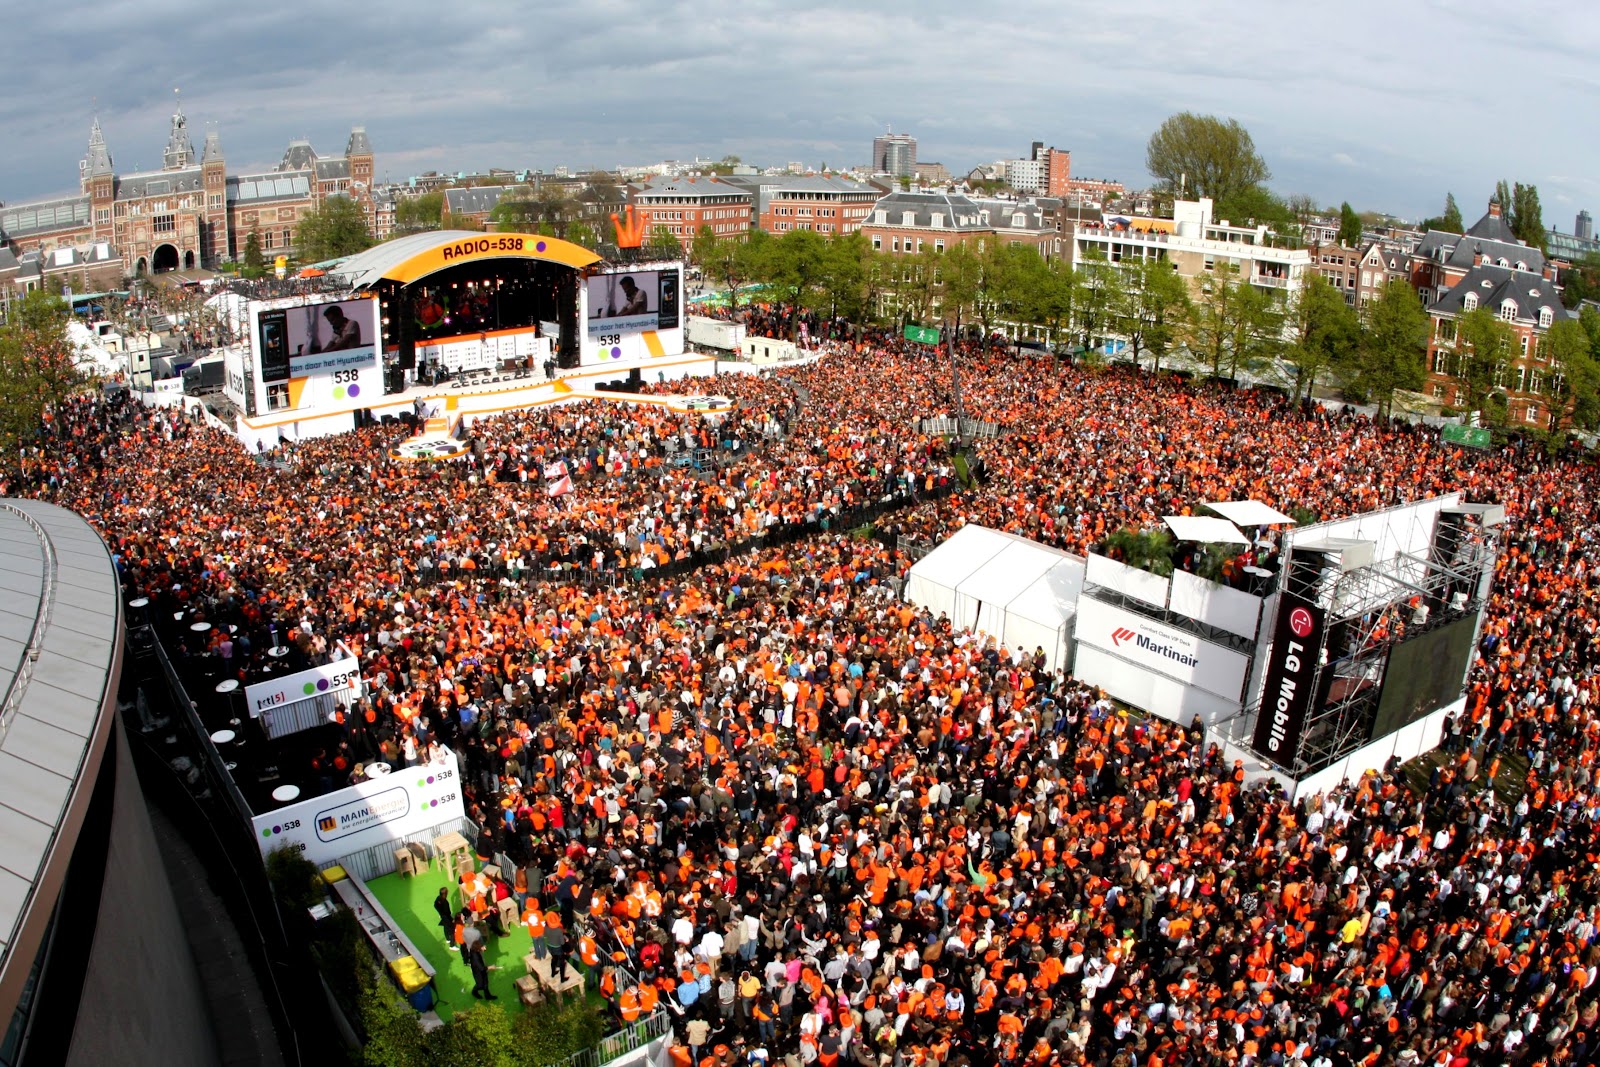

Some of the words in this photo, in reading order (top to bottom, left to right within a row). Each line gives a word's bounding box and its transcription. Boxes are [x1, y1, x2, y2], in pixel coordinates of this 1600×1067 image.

[600, 333, 621, 346] 538
[305, 362, 322, 370] door
[323, 359, 335, 367] het
[335, 368, 359, 384] 538
[1139, 624, 1158, 635] Comfort
[1158, 629, 1171, 640] Class
[1179, 637, 1191, 647] Deck
[1136, 633, 1199, 668] Martinair
[1285, 640, 1304, 673] LG
[1268, 677, 1297, 752] Mobile
[437, 769, 453, 781] 538
[441, 792, 456, 804] 538
[284, 819, 301, 831] 538
